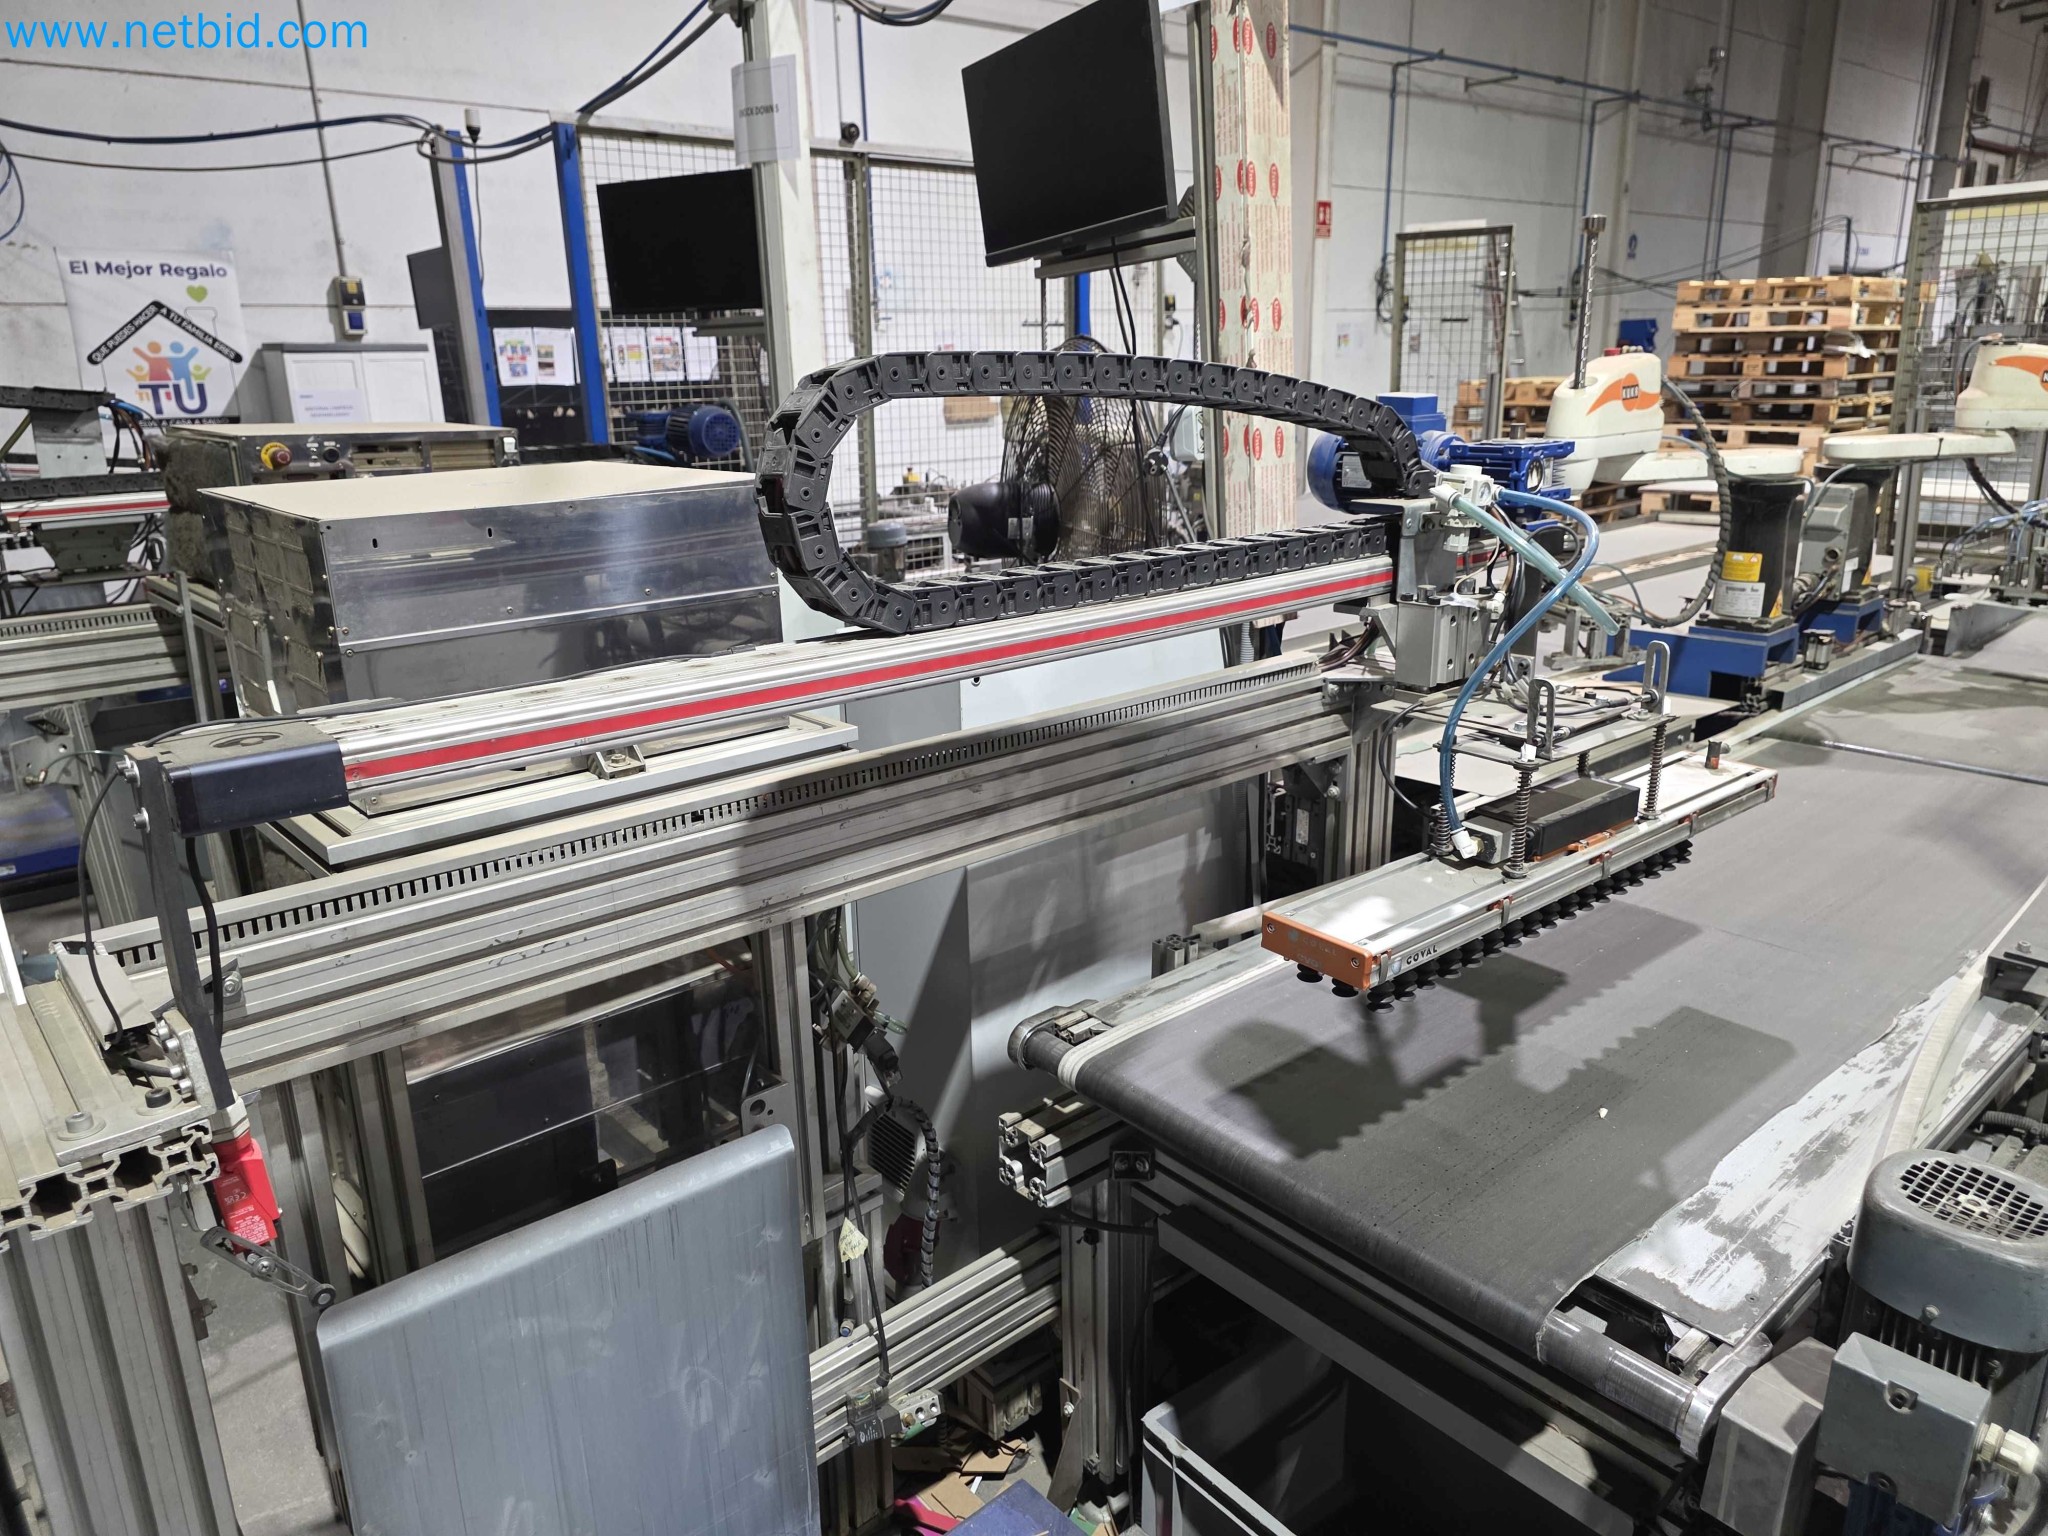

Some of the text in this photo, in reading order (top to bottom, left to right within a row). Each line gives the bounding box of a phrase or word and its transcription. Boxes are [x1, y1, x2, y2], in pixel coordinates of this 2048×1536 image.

[69, 260, 228, 280] El Mejor Regalo
[159, 306, 168, 316] A
[169, 312, 182, 324] TU
[181, 318, 214, 345] FAMILIA
[91, 340, 109, 362] QUE
[138, 382, 208, 415] TU
[1406, 945, 1438, 965] COVAL
